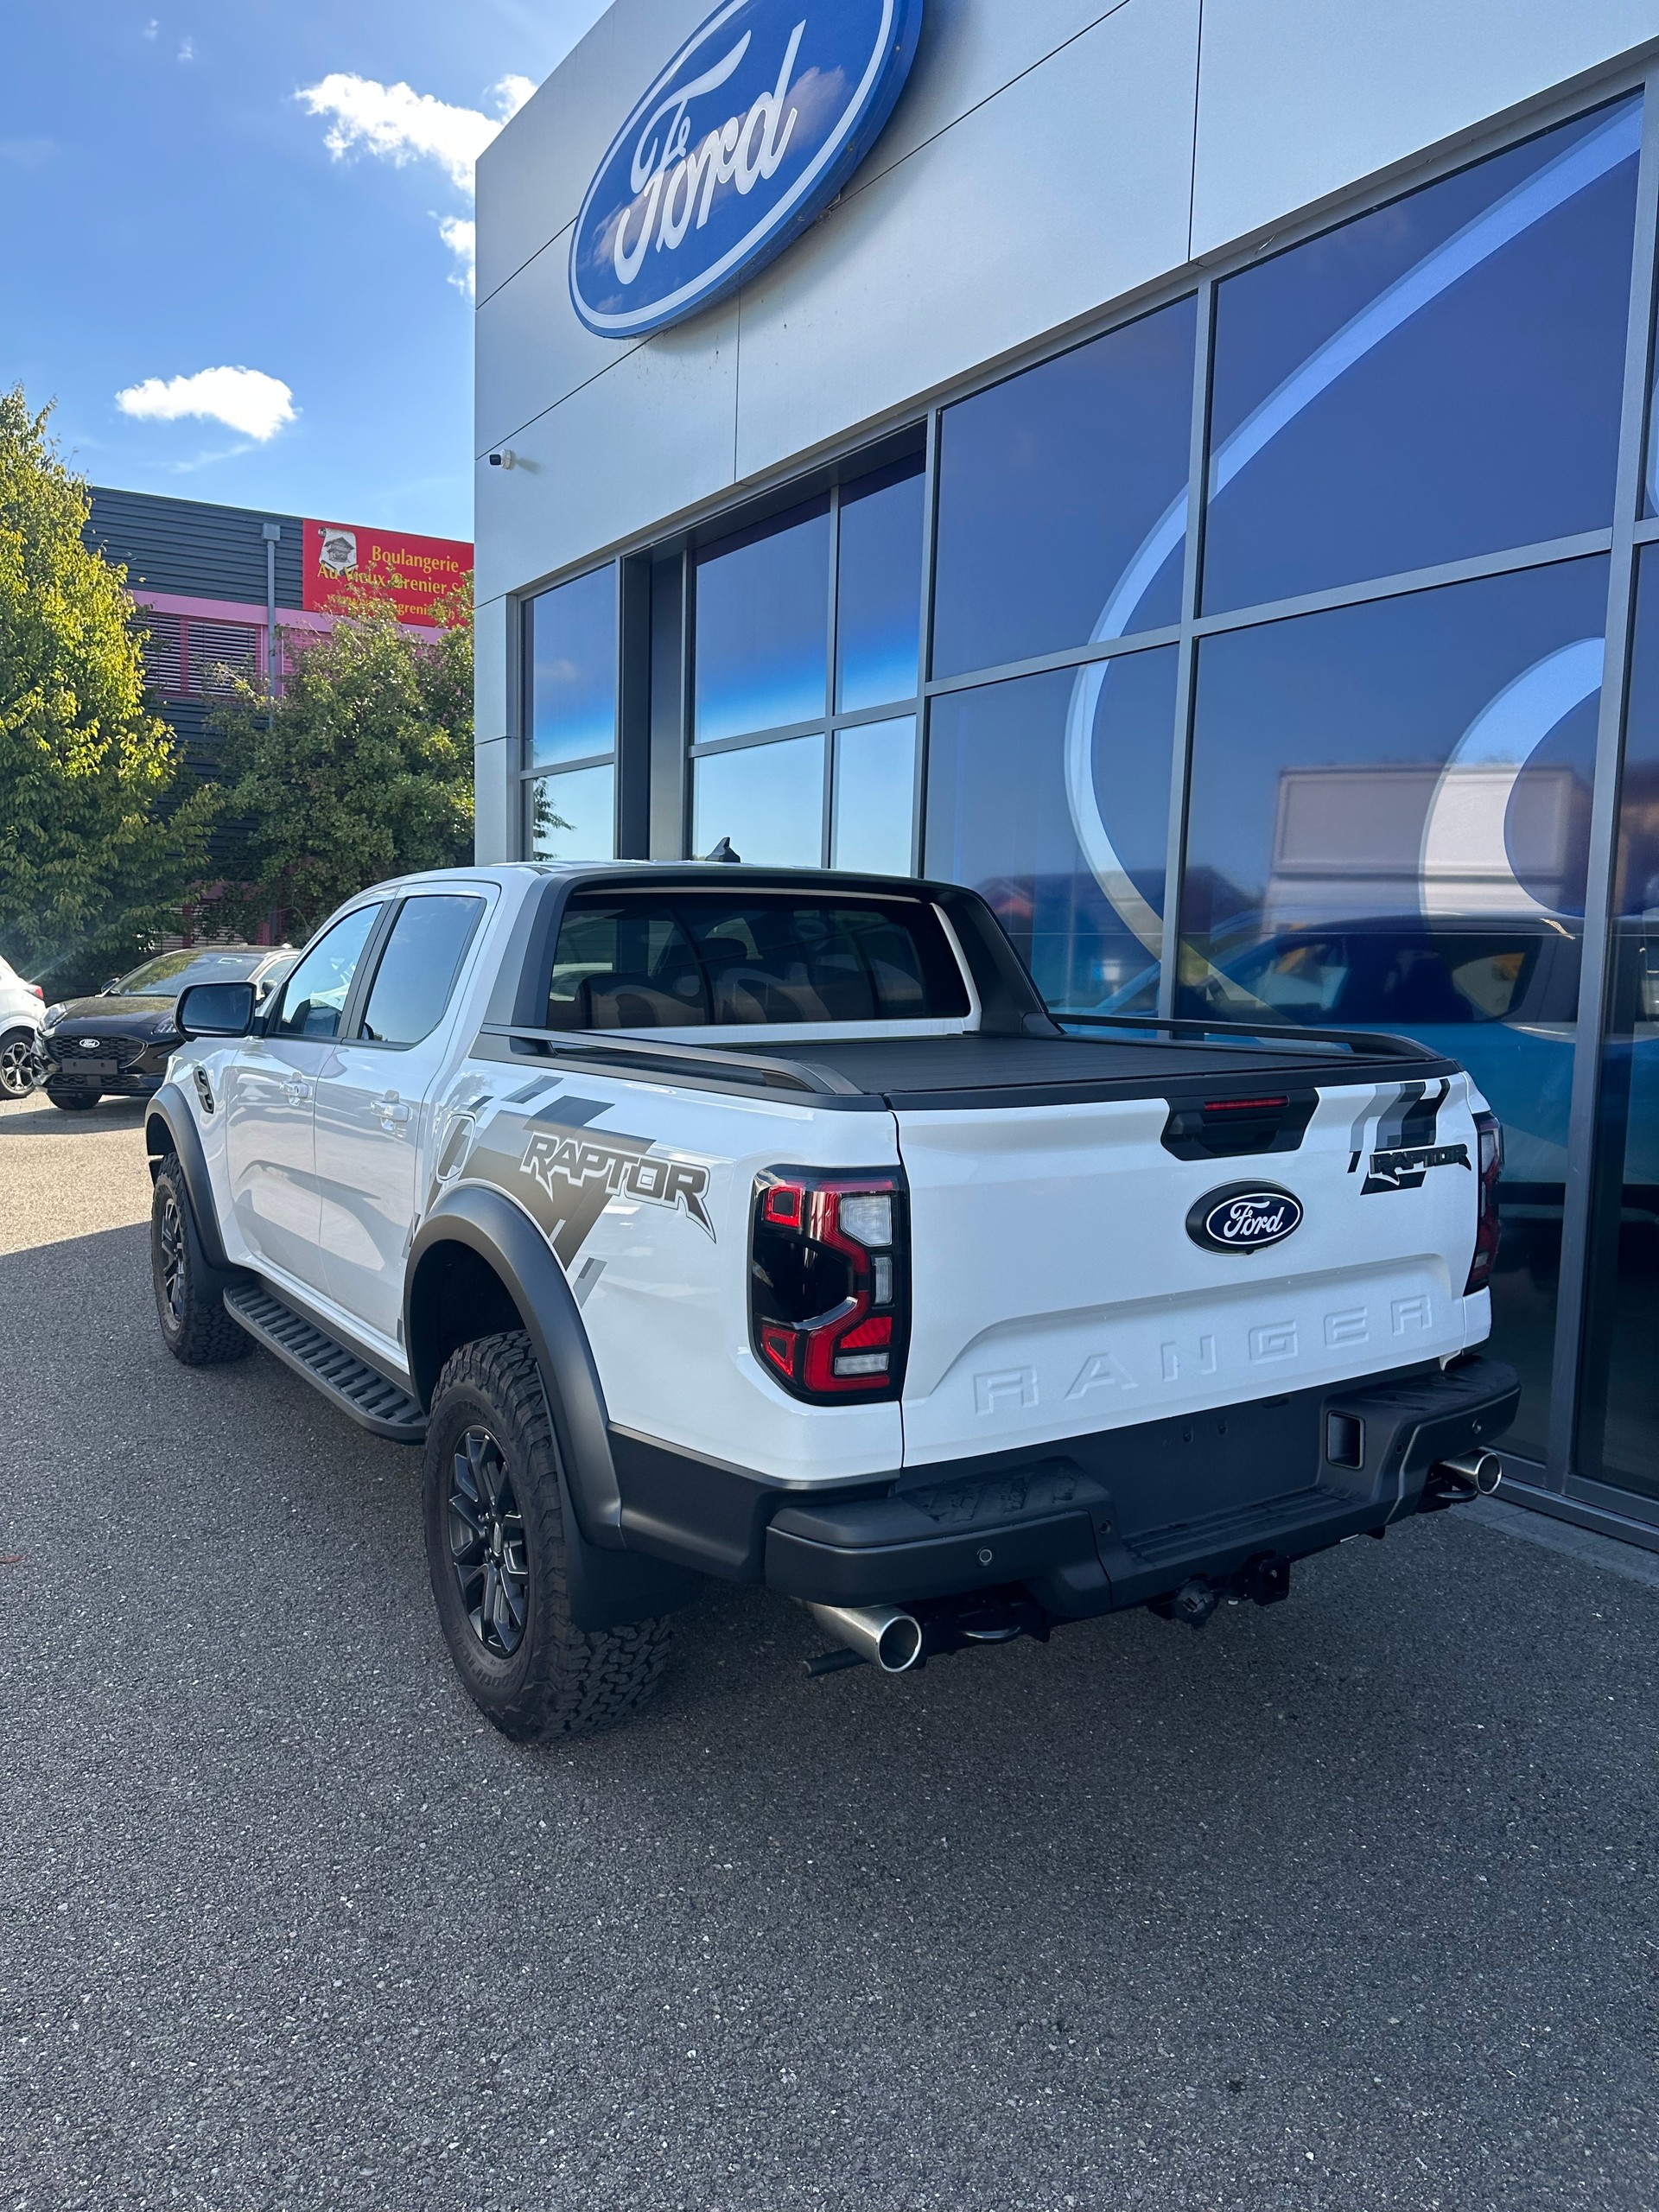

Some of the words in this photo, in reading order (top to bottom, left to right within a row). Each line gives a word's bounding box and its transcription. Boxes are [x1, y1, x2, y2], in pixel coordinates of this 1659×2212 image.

[614, 19, 806, 284] Ford
[317, 563, 338, 580] Au
[391, 573, 447, 594] Grenier
[372, 545, 459, 574] Boulangerie
[1370, 1143, 1472, 1185] RAPTOR
[519, 1129, 716, 1244] RAPTOR
[1224, 1201, 1285, 1237] Ford
[973, 1294, 1433, 1415] RANGER
